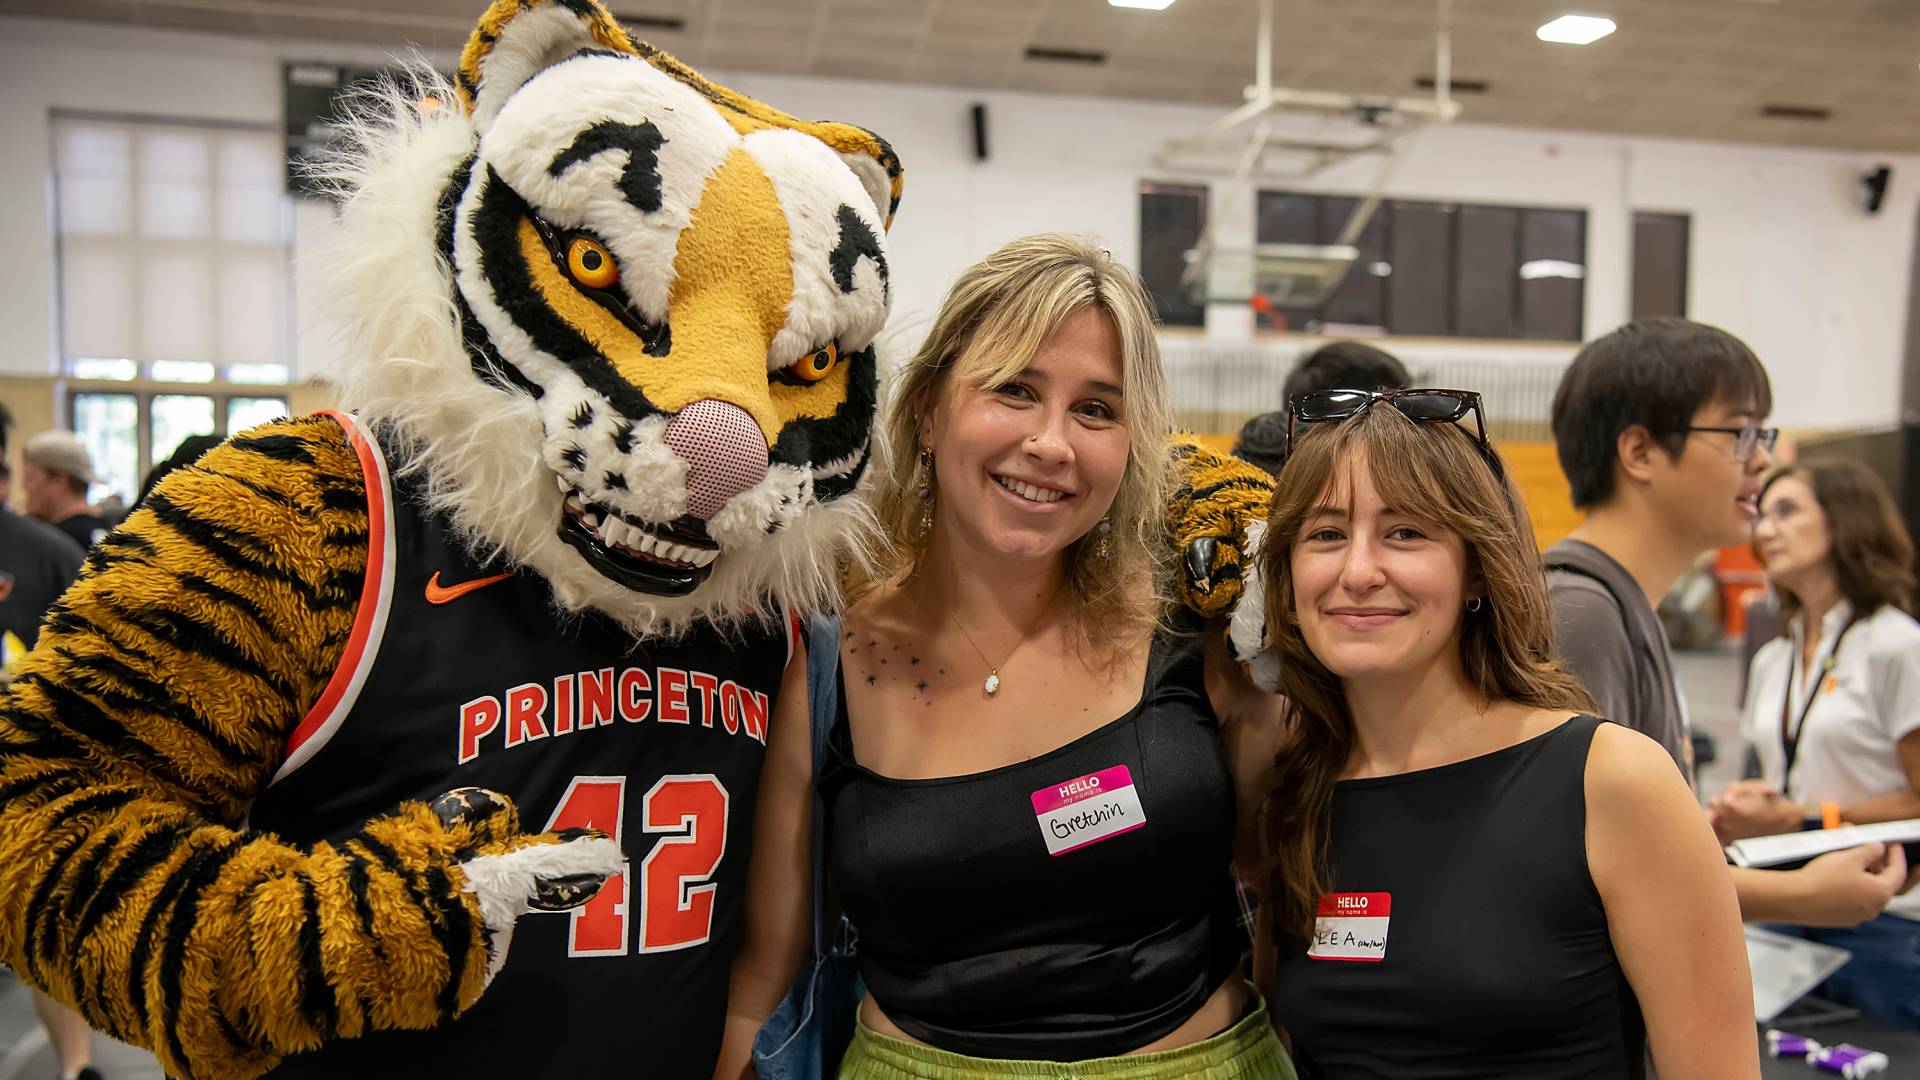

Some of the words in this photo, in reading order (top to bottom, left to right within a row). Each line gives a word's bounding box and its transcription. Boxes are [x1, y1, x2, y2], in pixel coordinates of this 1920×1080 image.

[459, 667, 768, 764] PRINCETON
[1059, 776, 1100, 798] HELLO
[1075, 790, 1094, 800] name
[1050, 803, 1124, 839] Gretchin
[532, 774, 729, 957] 42
[1337, 897, 1368, 908] HELLO
